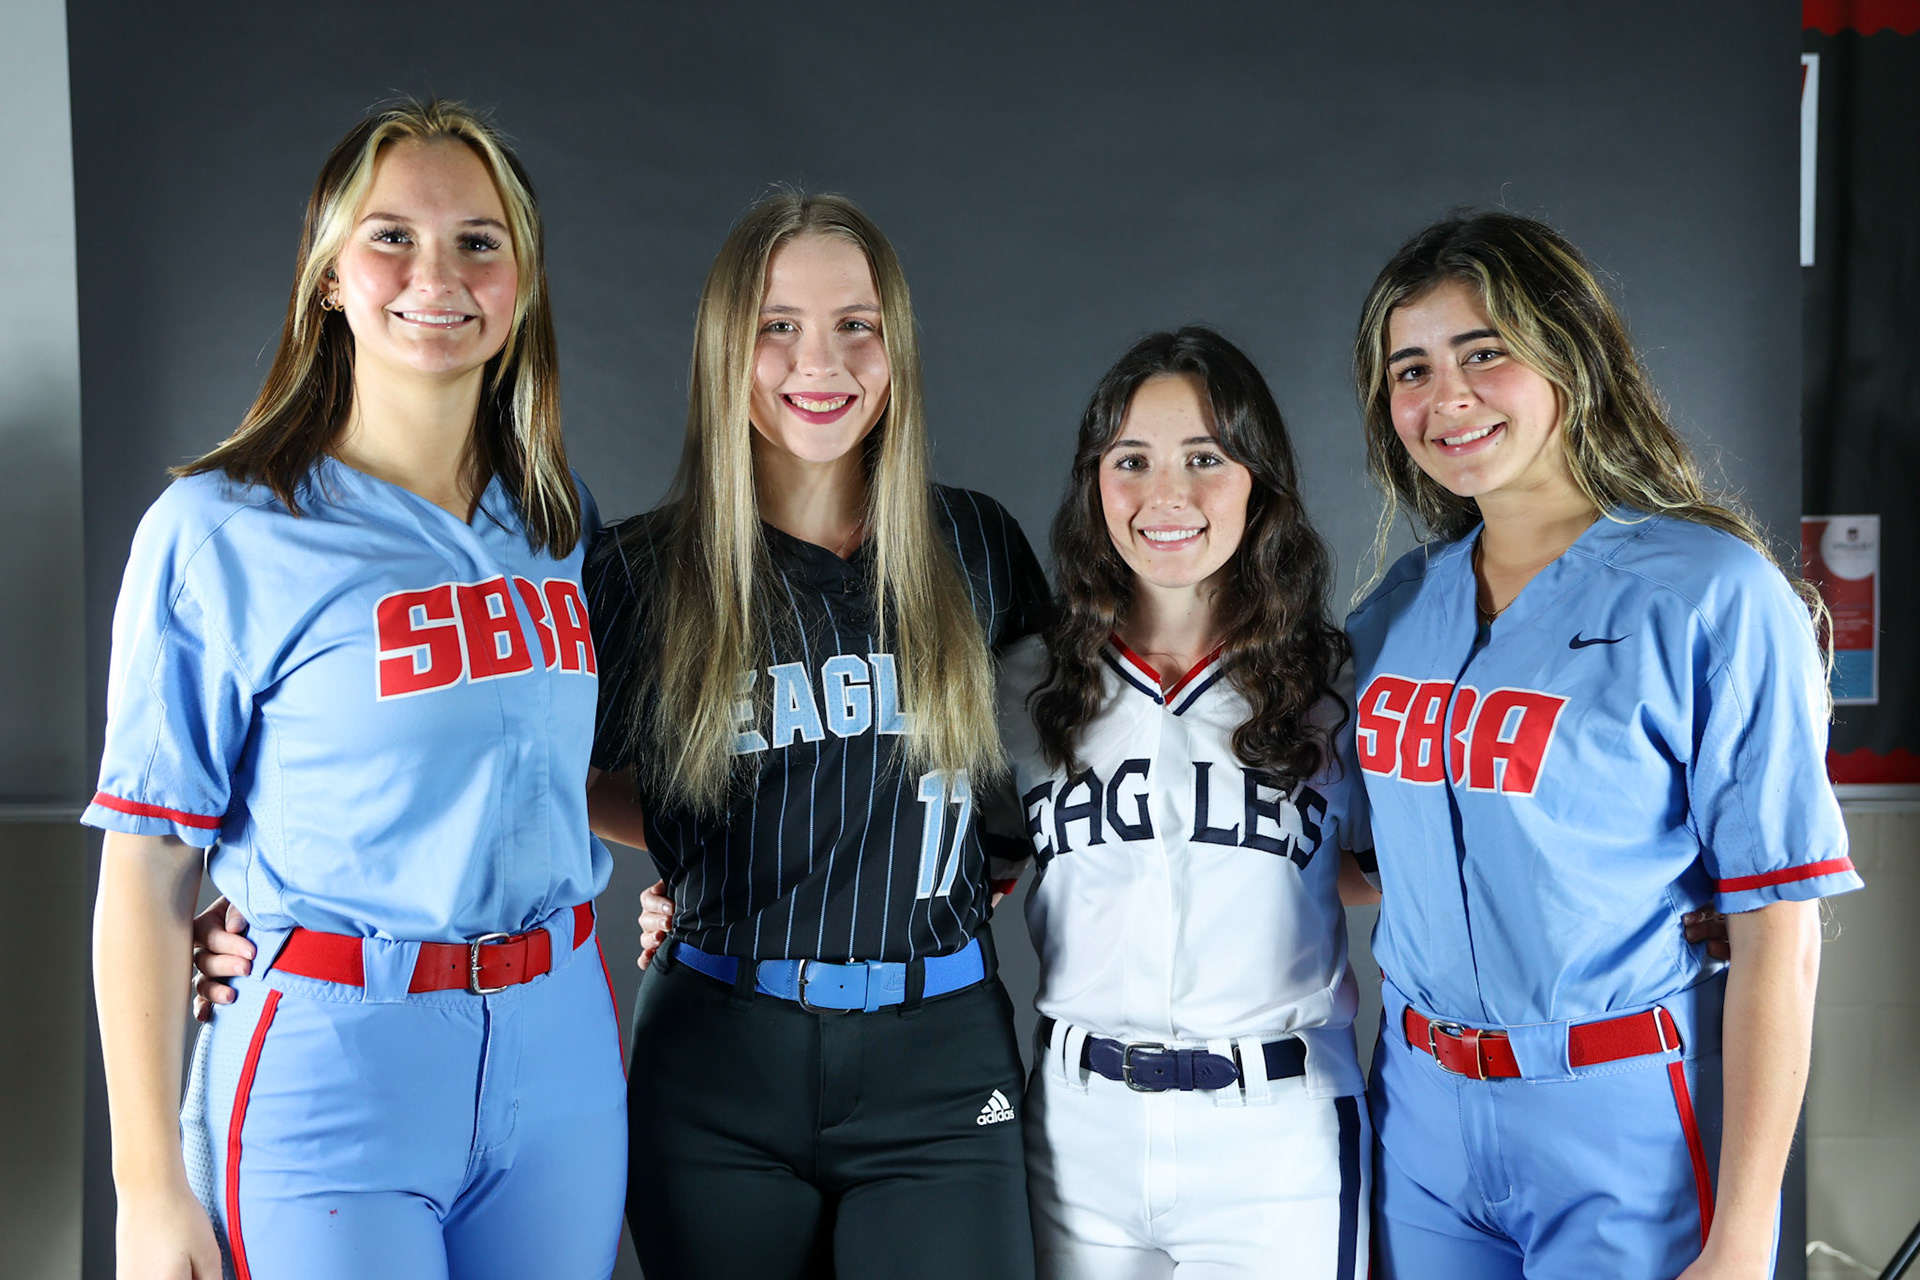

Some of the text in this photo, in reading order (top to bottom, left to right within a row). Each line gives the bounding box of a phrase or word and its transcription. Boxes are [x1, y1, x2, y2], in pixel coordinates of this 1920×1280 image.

[373, 574, 598, 702] SBA
[728, 653, 926, 755] EAGL
[1356, 672, 1572, 798] SBA
[916, 768, 972, 900] 17
[1022, 758, 1328, 874] EAGLES
[976, 1109, 1015, 1126] adidas
